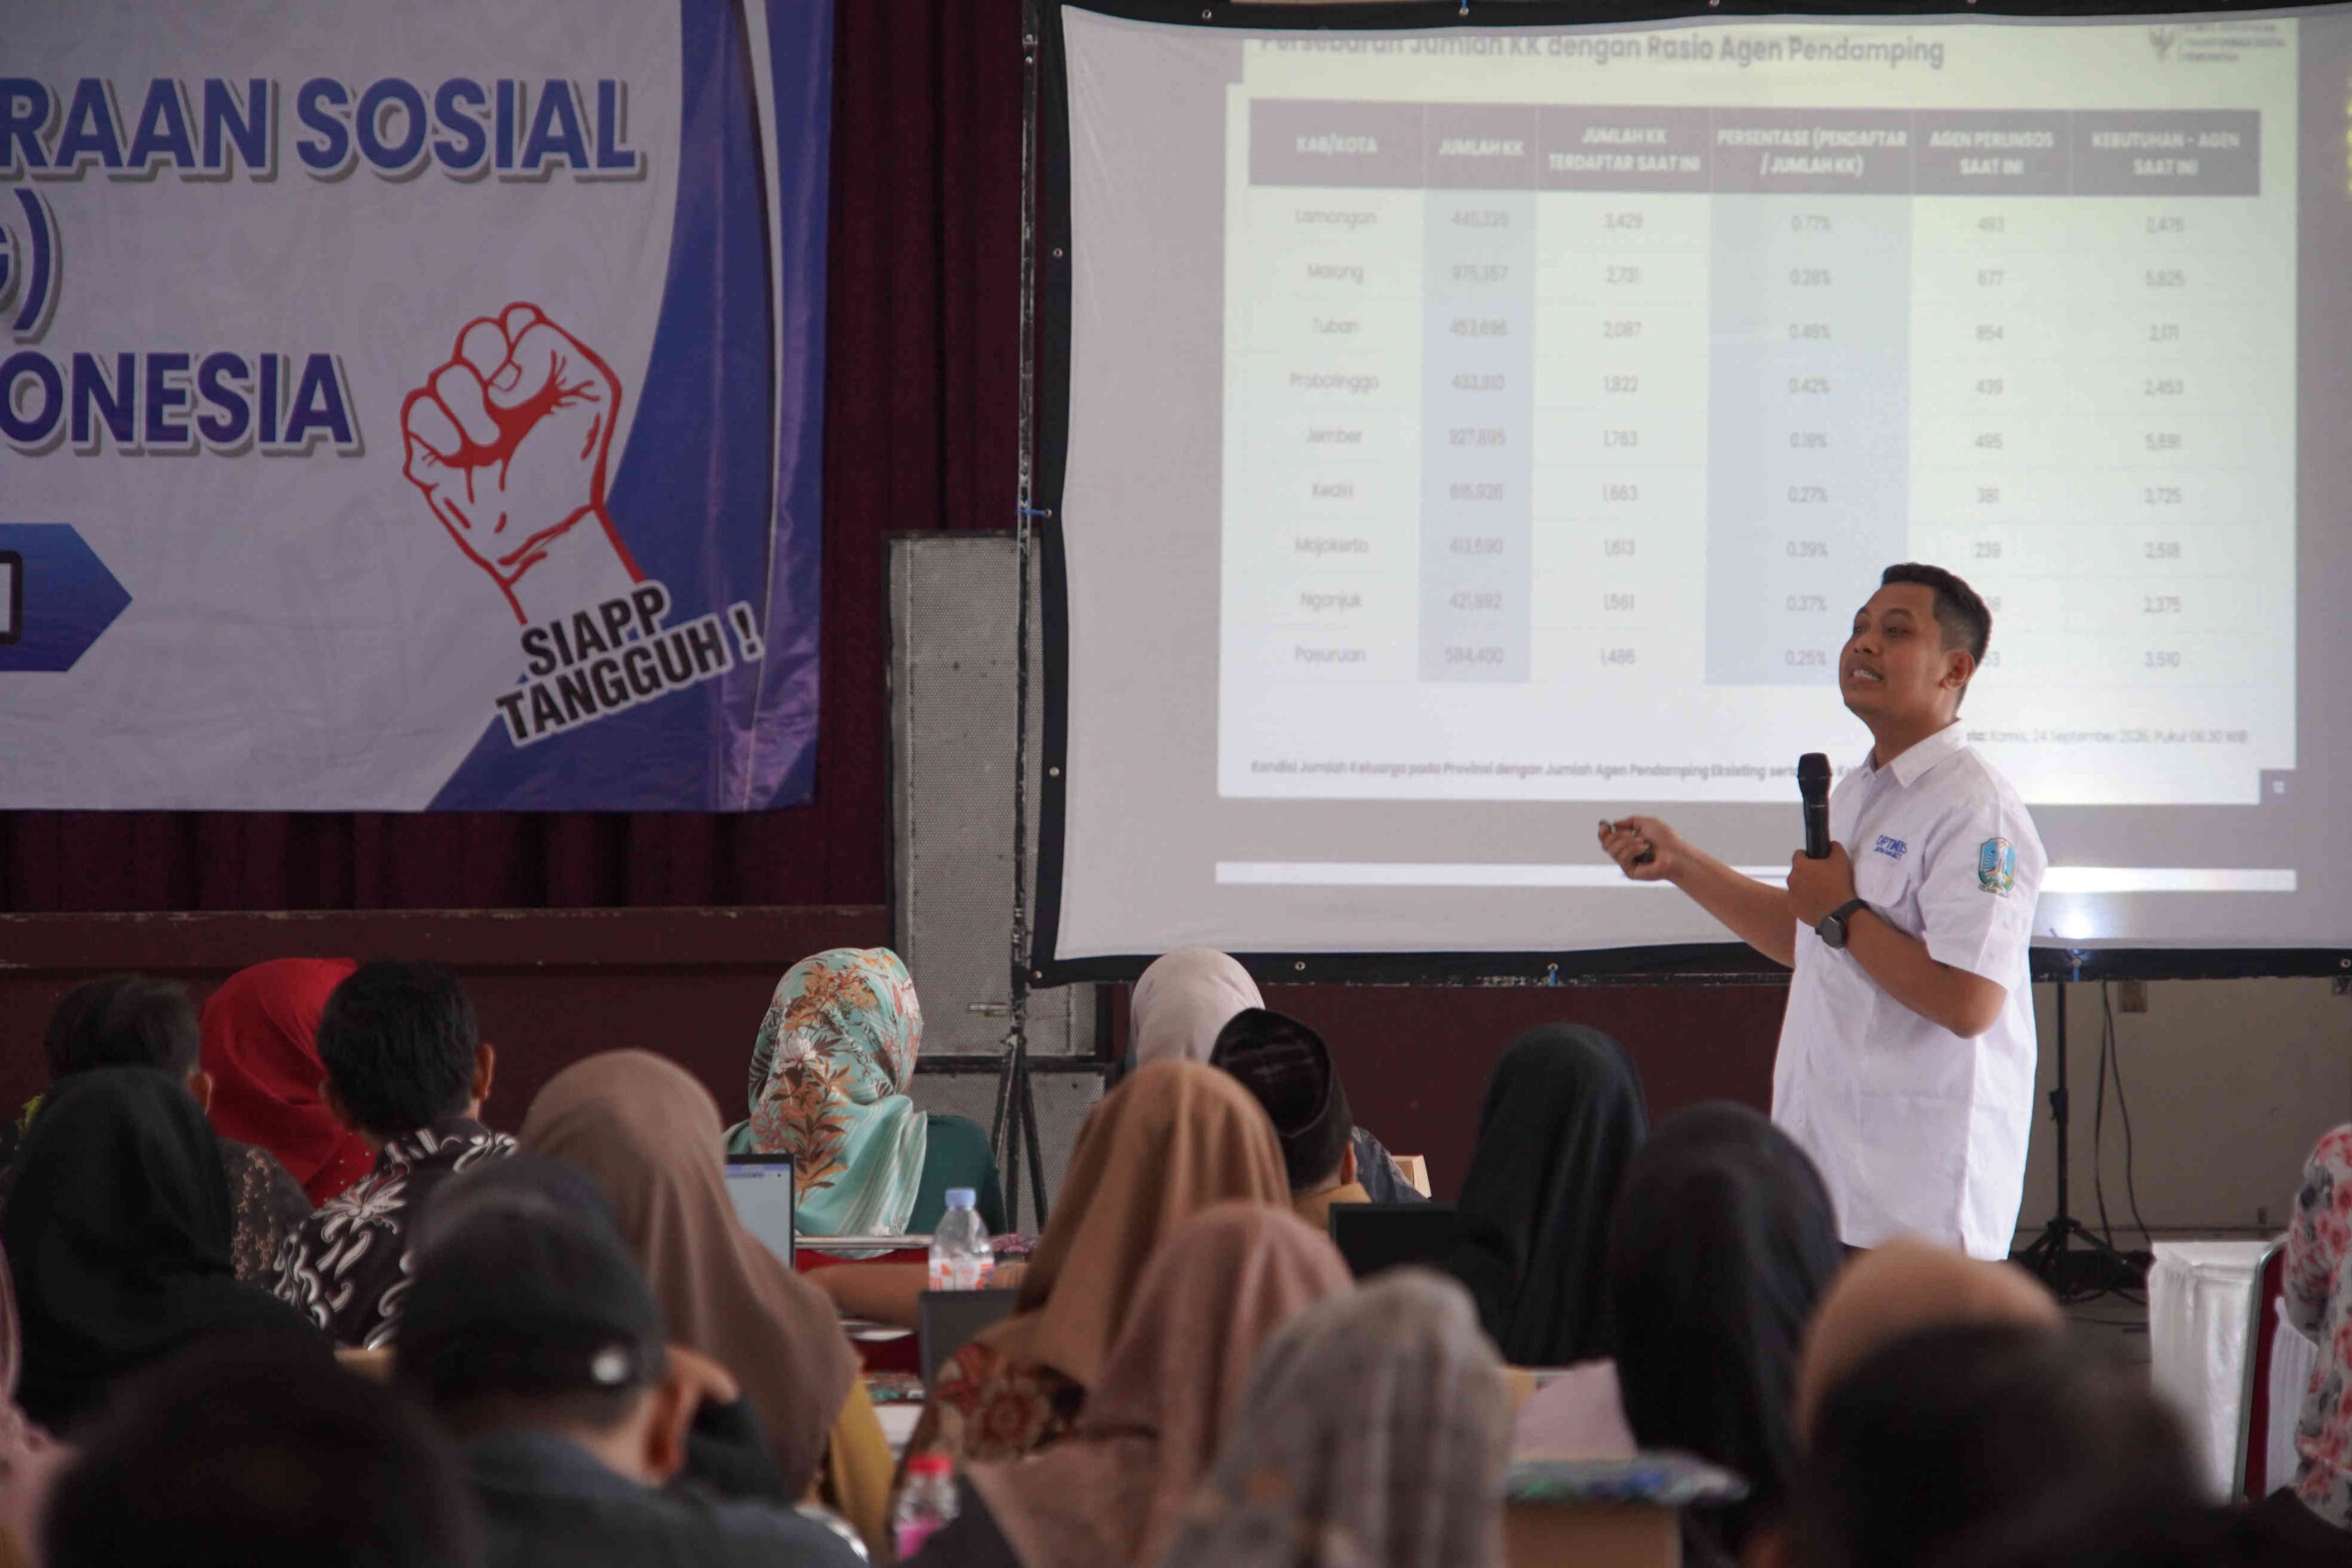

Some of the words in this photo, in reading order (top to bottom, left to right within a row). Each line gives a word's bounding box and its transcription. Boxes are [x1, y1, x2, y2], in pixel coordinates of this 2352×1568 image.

[1411, 37, 1504, 57] Jumlah
[1510, 36, 1544, 58] KK
[1547, 36, 1640, 65] dengan
[1647, 35, 1712, 61] Rasio
[1718, 35, 1782, 67] Agen
[1789, 36, 1945, 70] Pendamping
[298, 77, 636, 169] SOSIAL
[1582, 128, 1642, 144] JUMLAH
[1644, 128, 1667, 144] KK
[1929, 130, 1972, 148] AGEN
[2198, 131, 2240, 148] AGEN
[1439, 140, 1500, 156] JUMLAH
[1502, 140, 1525, 156] KK
[1637, 153, 1676, 172] SAAT
[1960, 159, 1999, 175] SAAT
[2133, 159, 2173, 175] SAAT
[1295, 209, 1378, 231] Lamongan
[0, 351, 352, 443] ONESIA
[1306, 427, 1363, 445] Jember
[1311, 482, 1354, 499] Kediri
[1295, 536, 1370, 558] Mojokerto
[1300, 592, 1362, 613] Nganjuk
[521, 585, 663, 676] SIAPP
[1295, 645, 1366, 663] Pasuruan
[496, 621, 727, 740] TANGGUH
[735, 609, 757, 655] !
[1496, 761, 1543, 779] dengan
[1546, 762, 1591, 776] Jumlah
[1595, 763, 1627, 780] Agen
[1630, 763, 1708, 781] Pendamping
